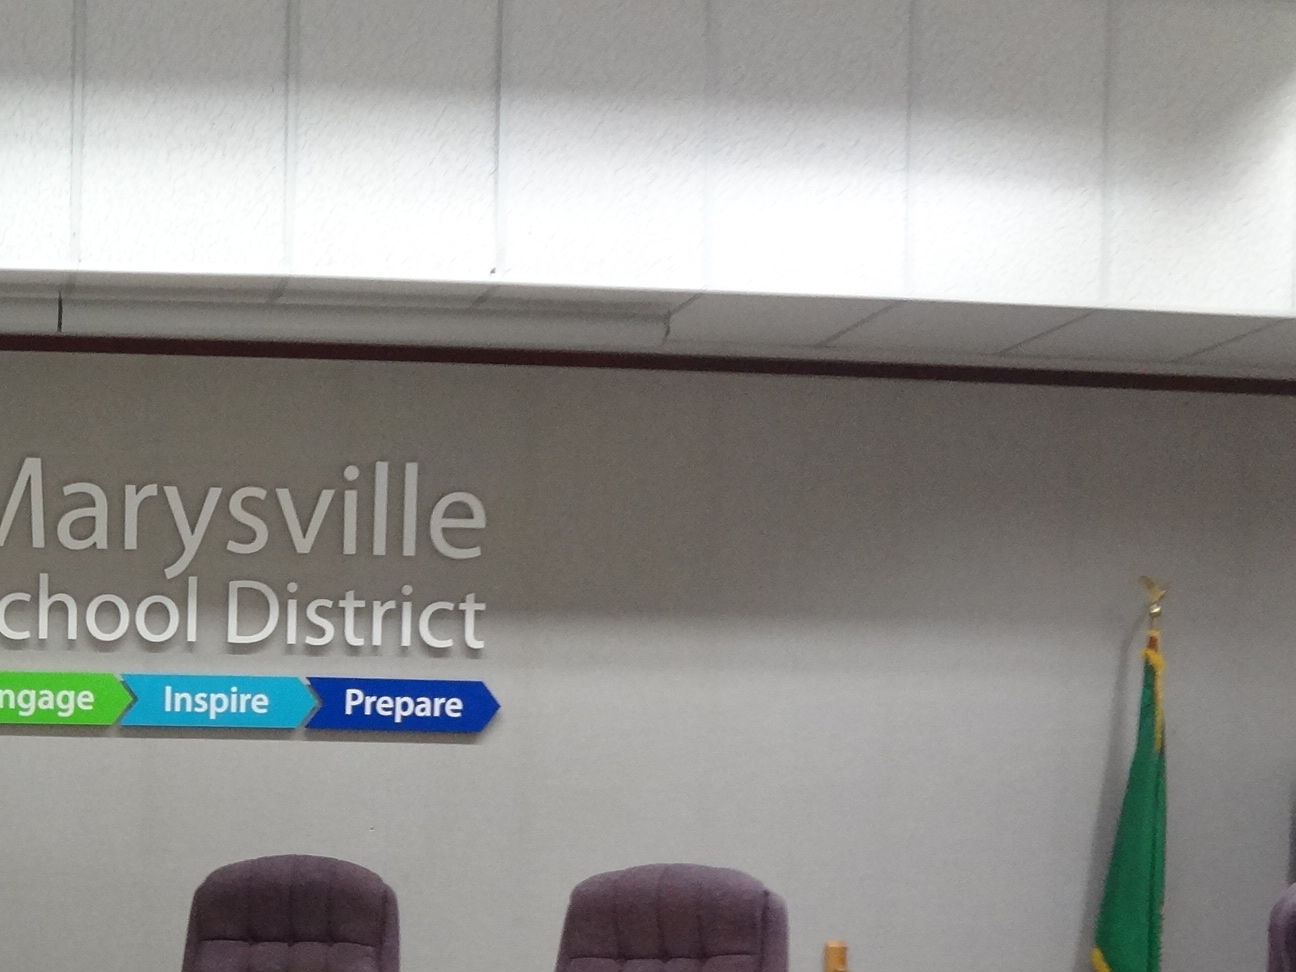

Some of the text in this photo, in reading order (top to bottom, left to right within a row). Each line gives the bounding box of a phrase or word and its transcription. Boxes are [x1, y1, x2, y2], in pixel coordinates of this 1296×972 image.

[226, 577, 487, 650] District
[163, 685, 270, 719] Inspire
[344, 687, 464, 723] Prepare
